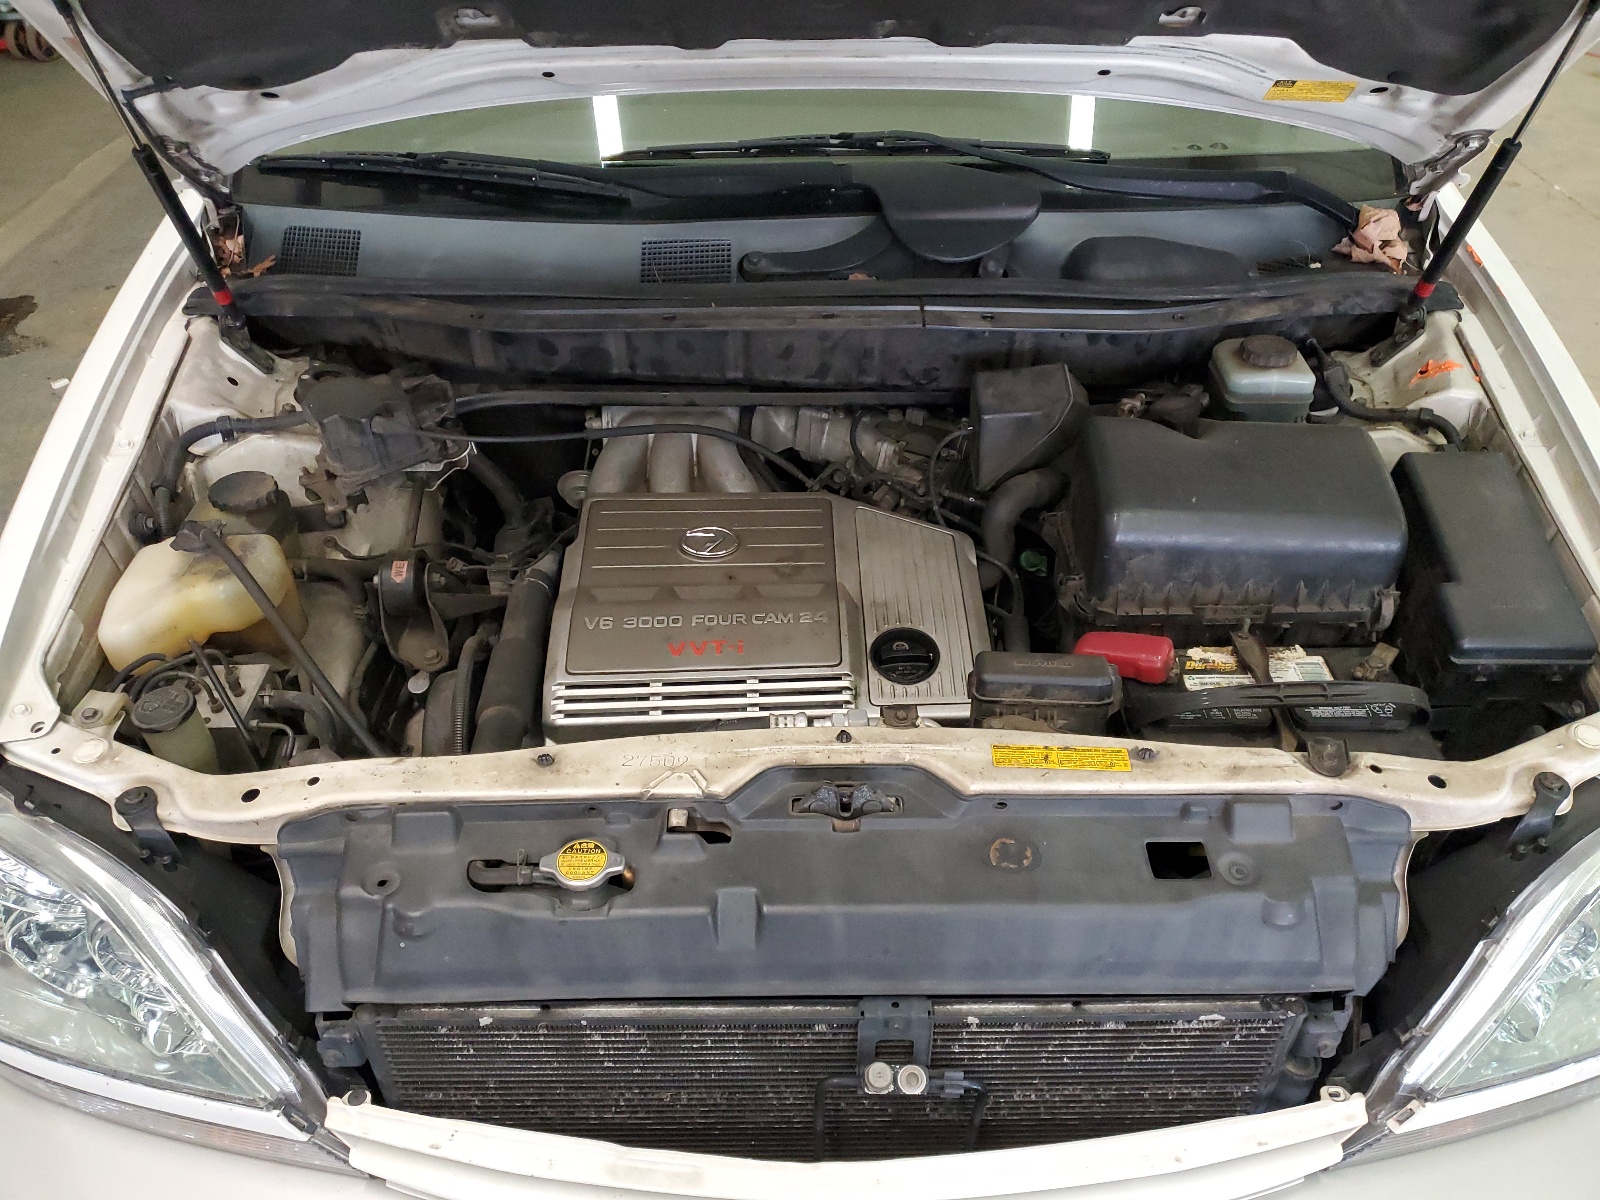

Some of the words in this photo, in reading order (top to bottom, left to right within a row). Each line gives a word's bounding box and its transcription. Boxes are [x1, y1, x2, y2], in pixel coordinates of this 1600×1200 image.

[584, 616, 614, 629] V6
[623, 615, 683, 628] 3000
[691, 613, 747, 627] FOUR
[751, 612, 794, 625] CAM
[799, 611, 828, 623] 24
[667, 639, 744, 657] VVT-i
